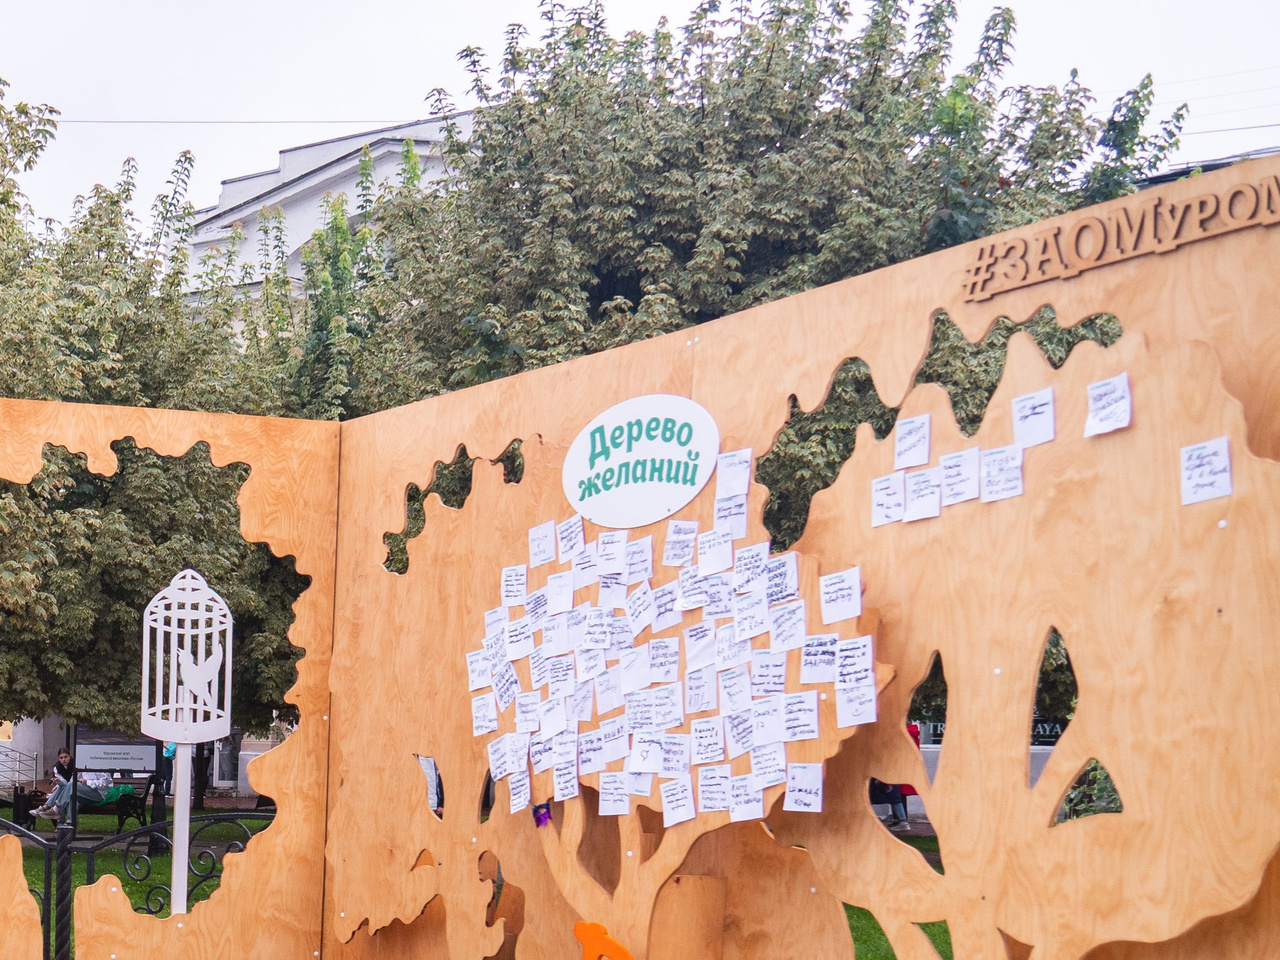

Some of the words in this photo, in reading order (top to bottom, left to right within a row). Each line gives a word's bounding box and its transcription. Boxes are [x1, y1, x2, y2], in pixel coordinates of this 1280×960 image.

[589, 417, 693, 470] Дерево
[578, 449, 700, 501] желаний
[927, 722, 945, 733] TR
[1031, 723, 1062, 735] AYA
